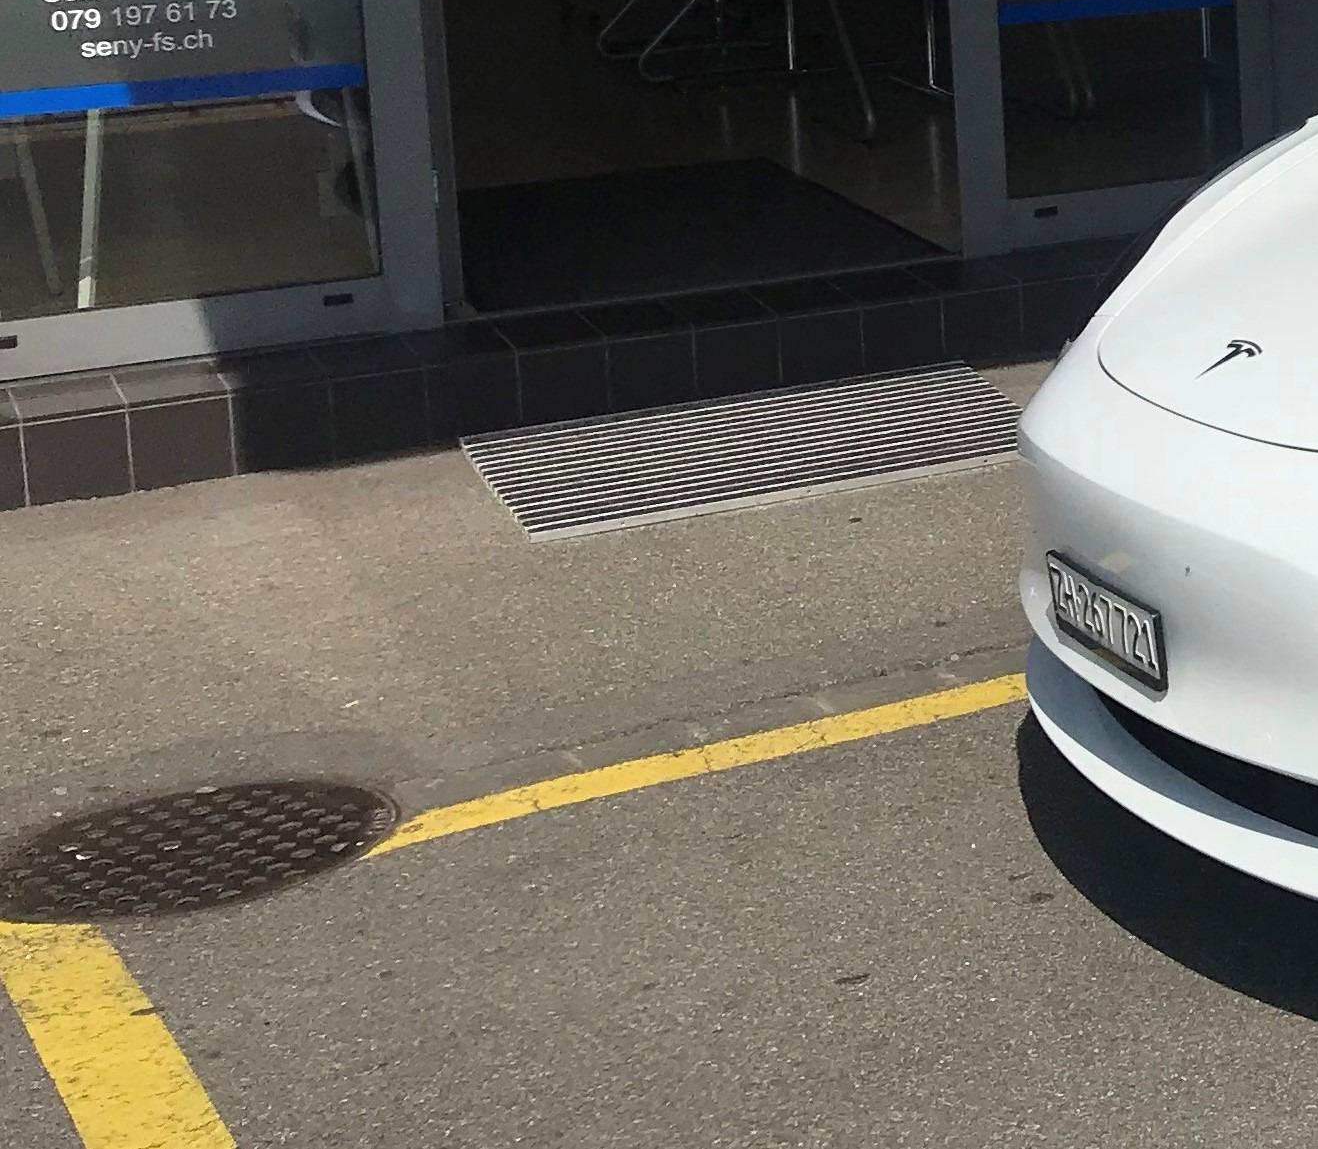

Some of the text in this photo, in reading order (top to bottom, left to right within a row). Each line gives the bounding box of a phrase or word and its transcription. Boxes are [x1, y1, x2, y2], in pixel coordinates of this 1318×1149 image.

[50, 8, 101, 32] 079
[110, 4, 157, 27] 197
[166, 1, 196, 23] 61
[80, 29, 214, 60] seny-fs.ch
